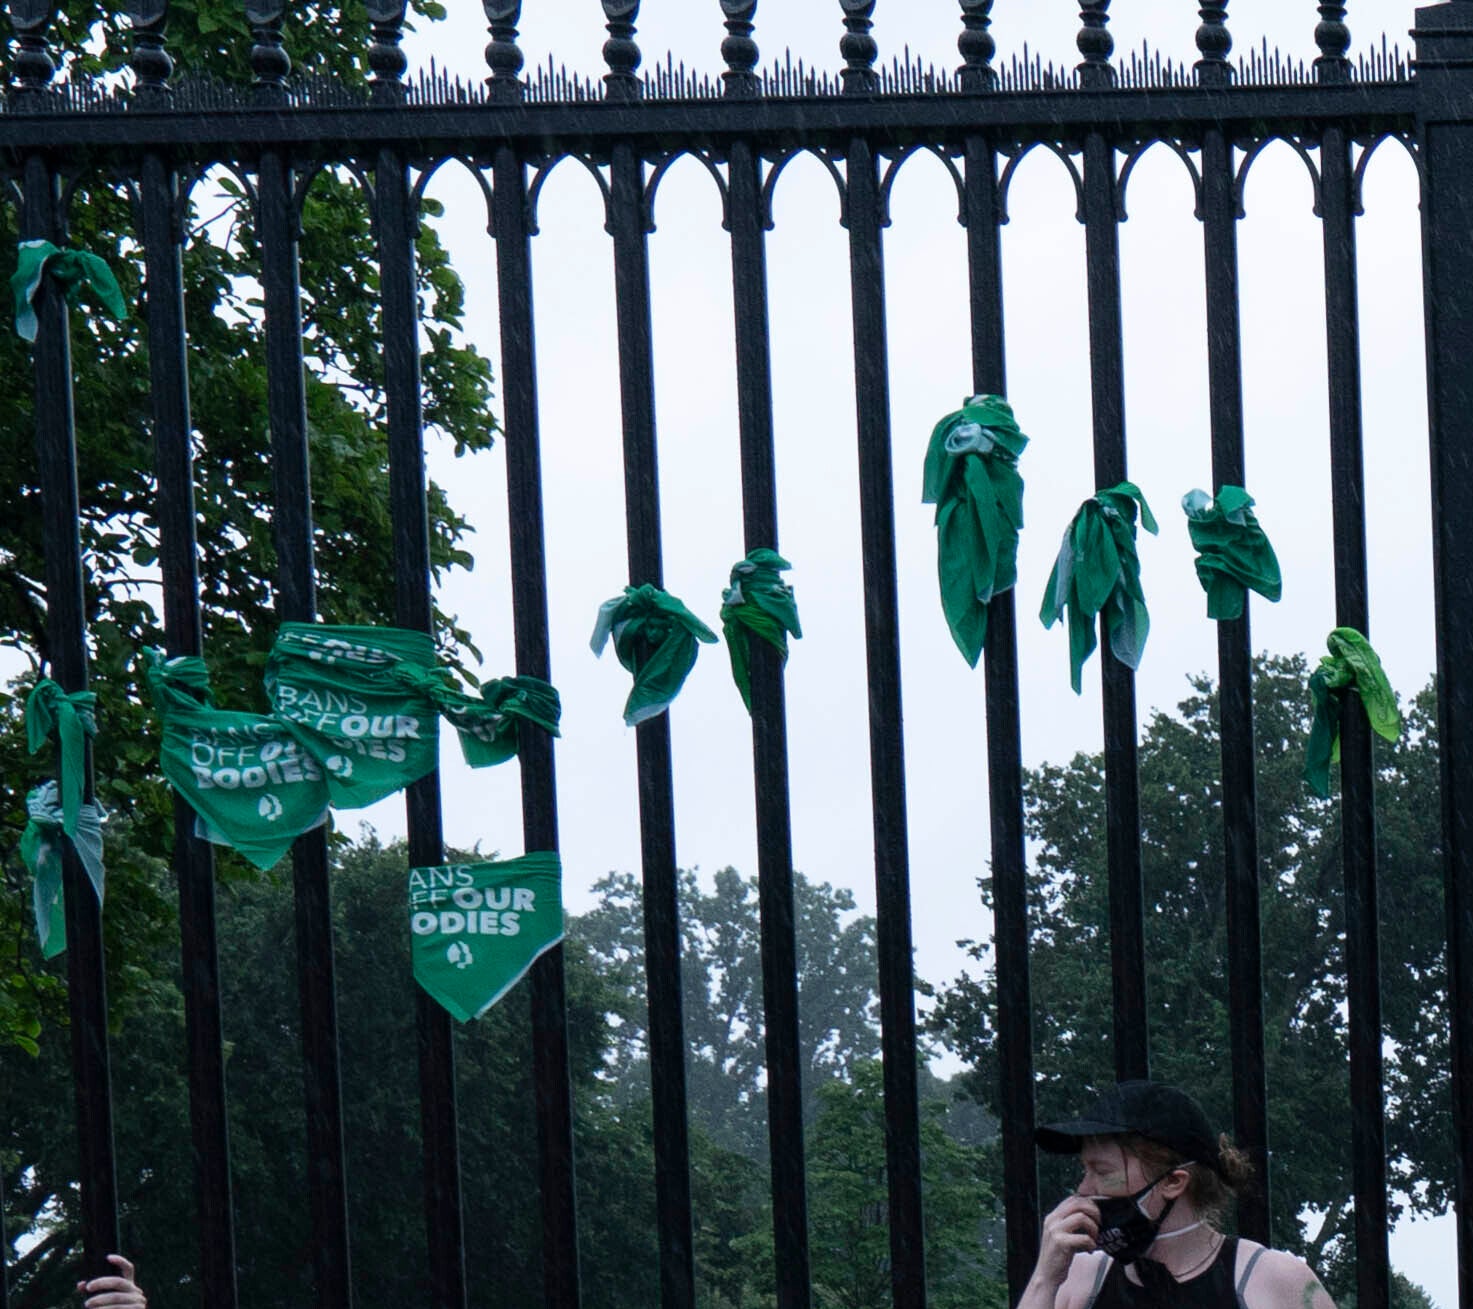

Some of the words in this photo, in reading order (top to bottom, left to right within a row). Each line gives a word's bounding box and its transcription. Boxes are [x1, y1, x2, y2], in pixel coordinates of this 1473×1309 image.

[278, 686, 368, 714] BANS
[341, 715, 420, 739] OUR
[192, 743, 255, 766] OFF
[409, 867, 474, 890] ANS
[411, 889, 447, 910] FF
[452, 887, 535, 911] OUR
[411, 911, 521, 936] ODIES
